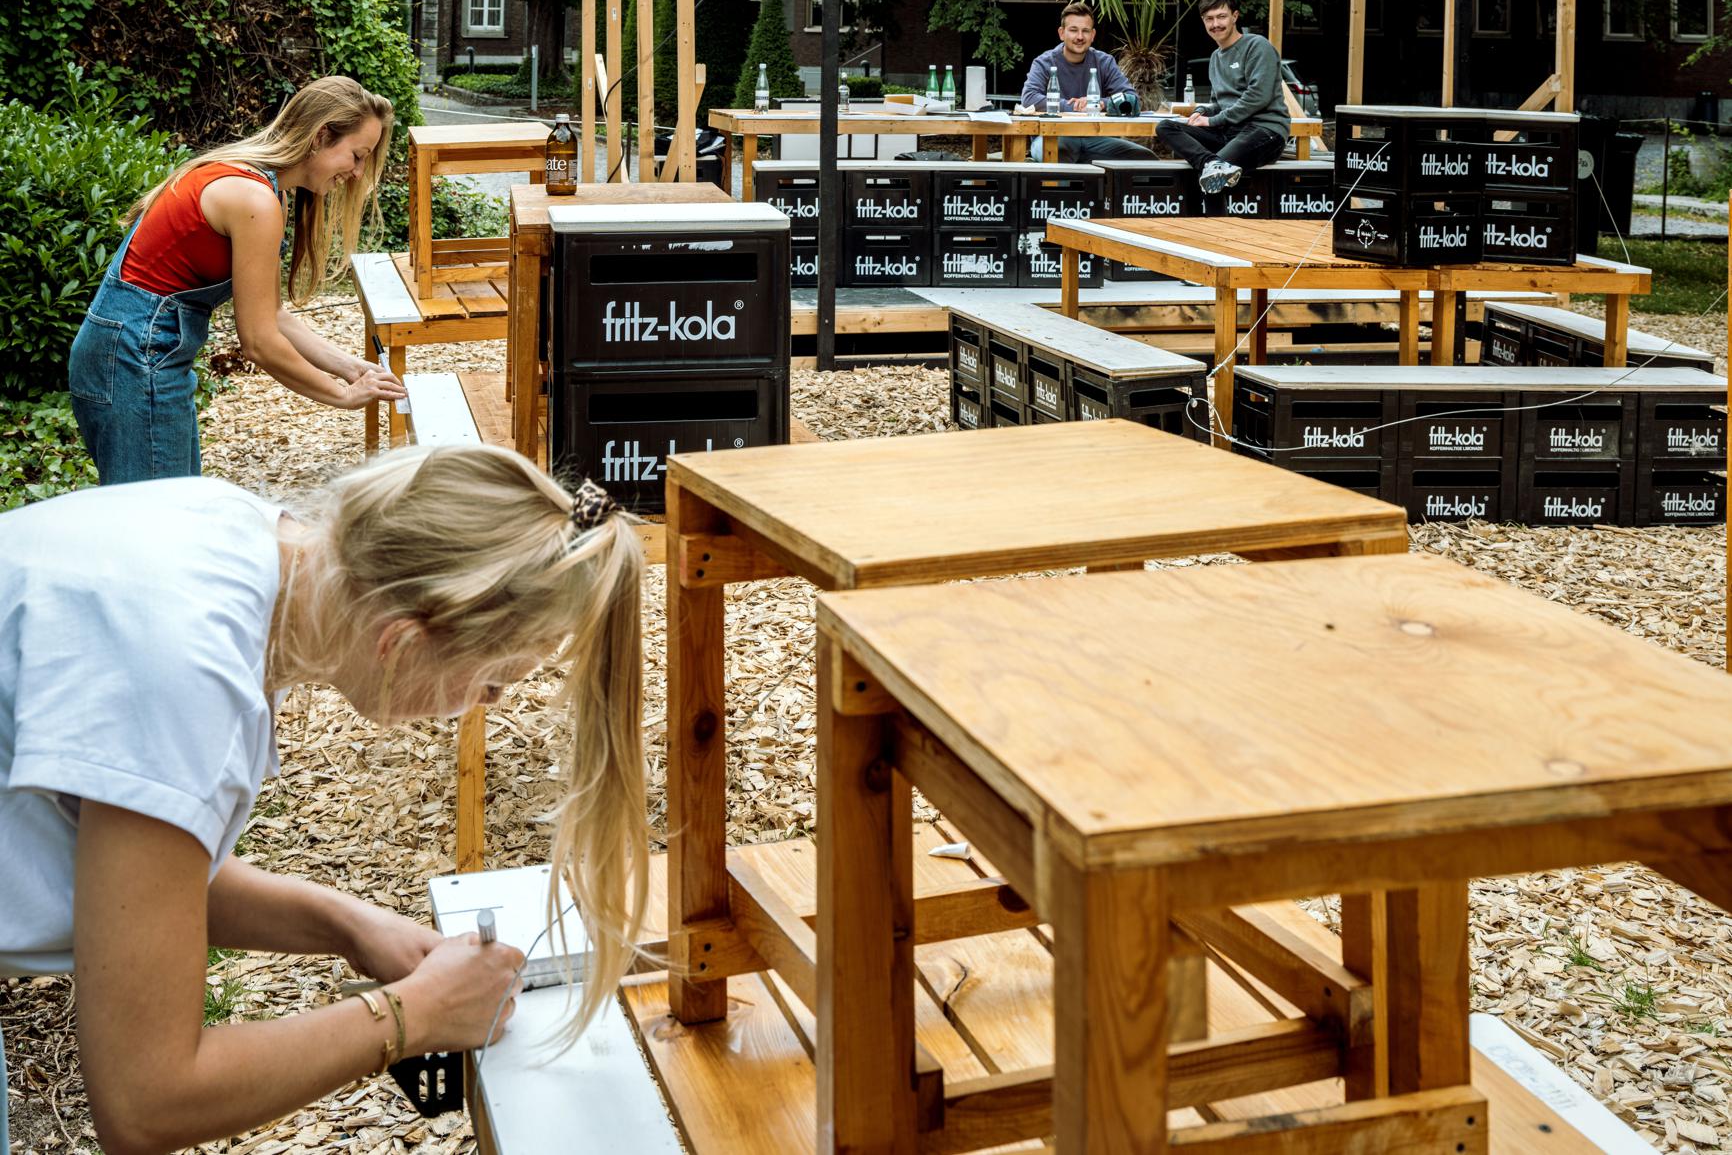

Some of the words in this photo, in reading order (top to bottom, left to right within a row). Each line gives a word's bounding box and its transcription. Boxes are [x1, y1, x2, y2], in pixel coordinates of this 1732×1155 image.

[546, 156, 567, 171] ate
[1347, 152, 1388, 173] fritz-kola
[1421, 153, 1469, 176] fritz-kola
[1485, 152, 1549, 178] itz-kola
[856, 198, 919, 218] fritz-kola
[943, 195, 1005, 216] fritz-kola
[1030, 199, 1091, 219] fritz-kola
[1122, 194, 1180, 214] fritz-kola
[1419, 225, 1467, 248] fritz-kola
[855, 255, 917, 276] fritz-kola
[1303, 425, 1365, 448] fritz-kola
[1429, 425, 1484, 446] fritz-kola
[1549, 427, 1603, 447] fritz-kola
[1667, 427, 1718, 447] fritz-kola
[1426, 494, 1486, 516] fritz-kola
[1544, 495, 1602, 517] fritz-kola
[1664, 492, 1716, 512] fritz-kola
